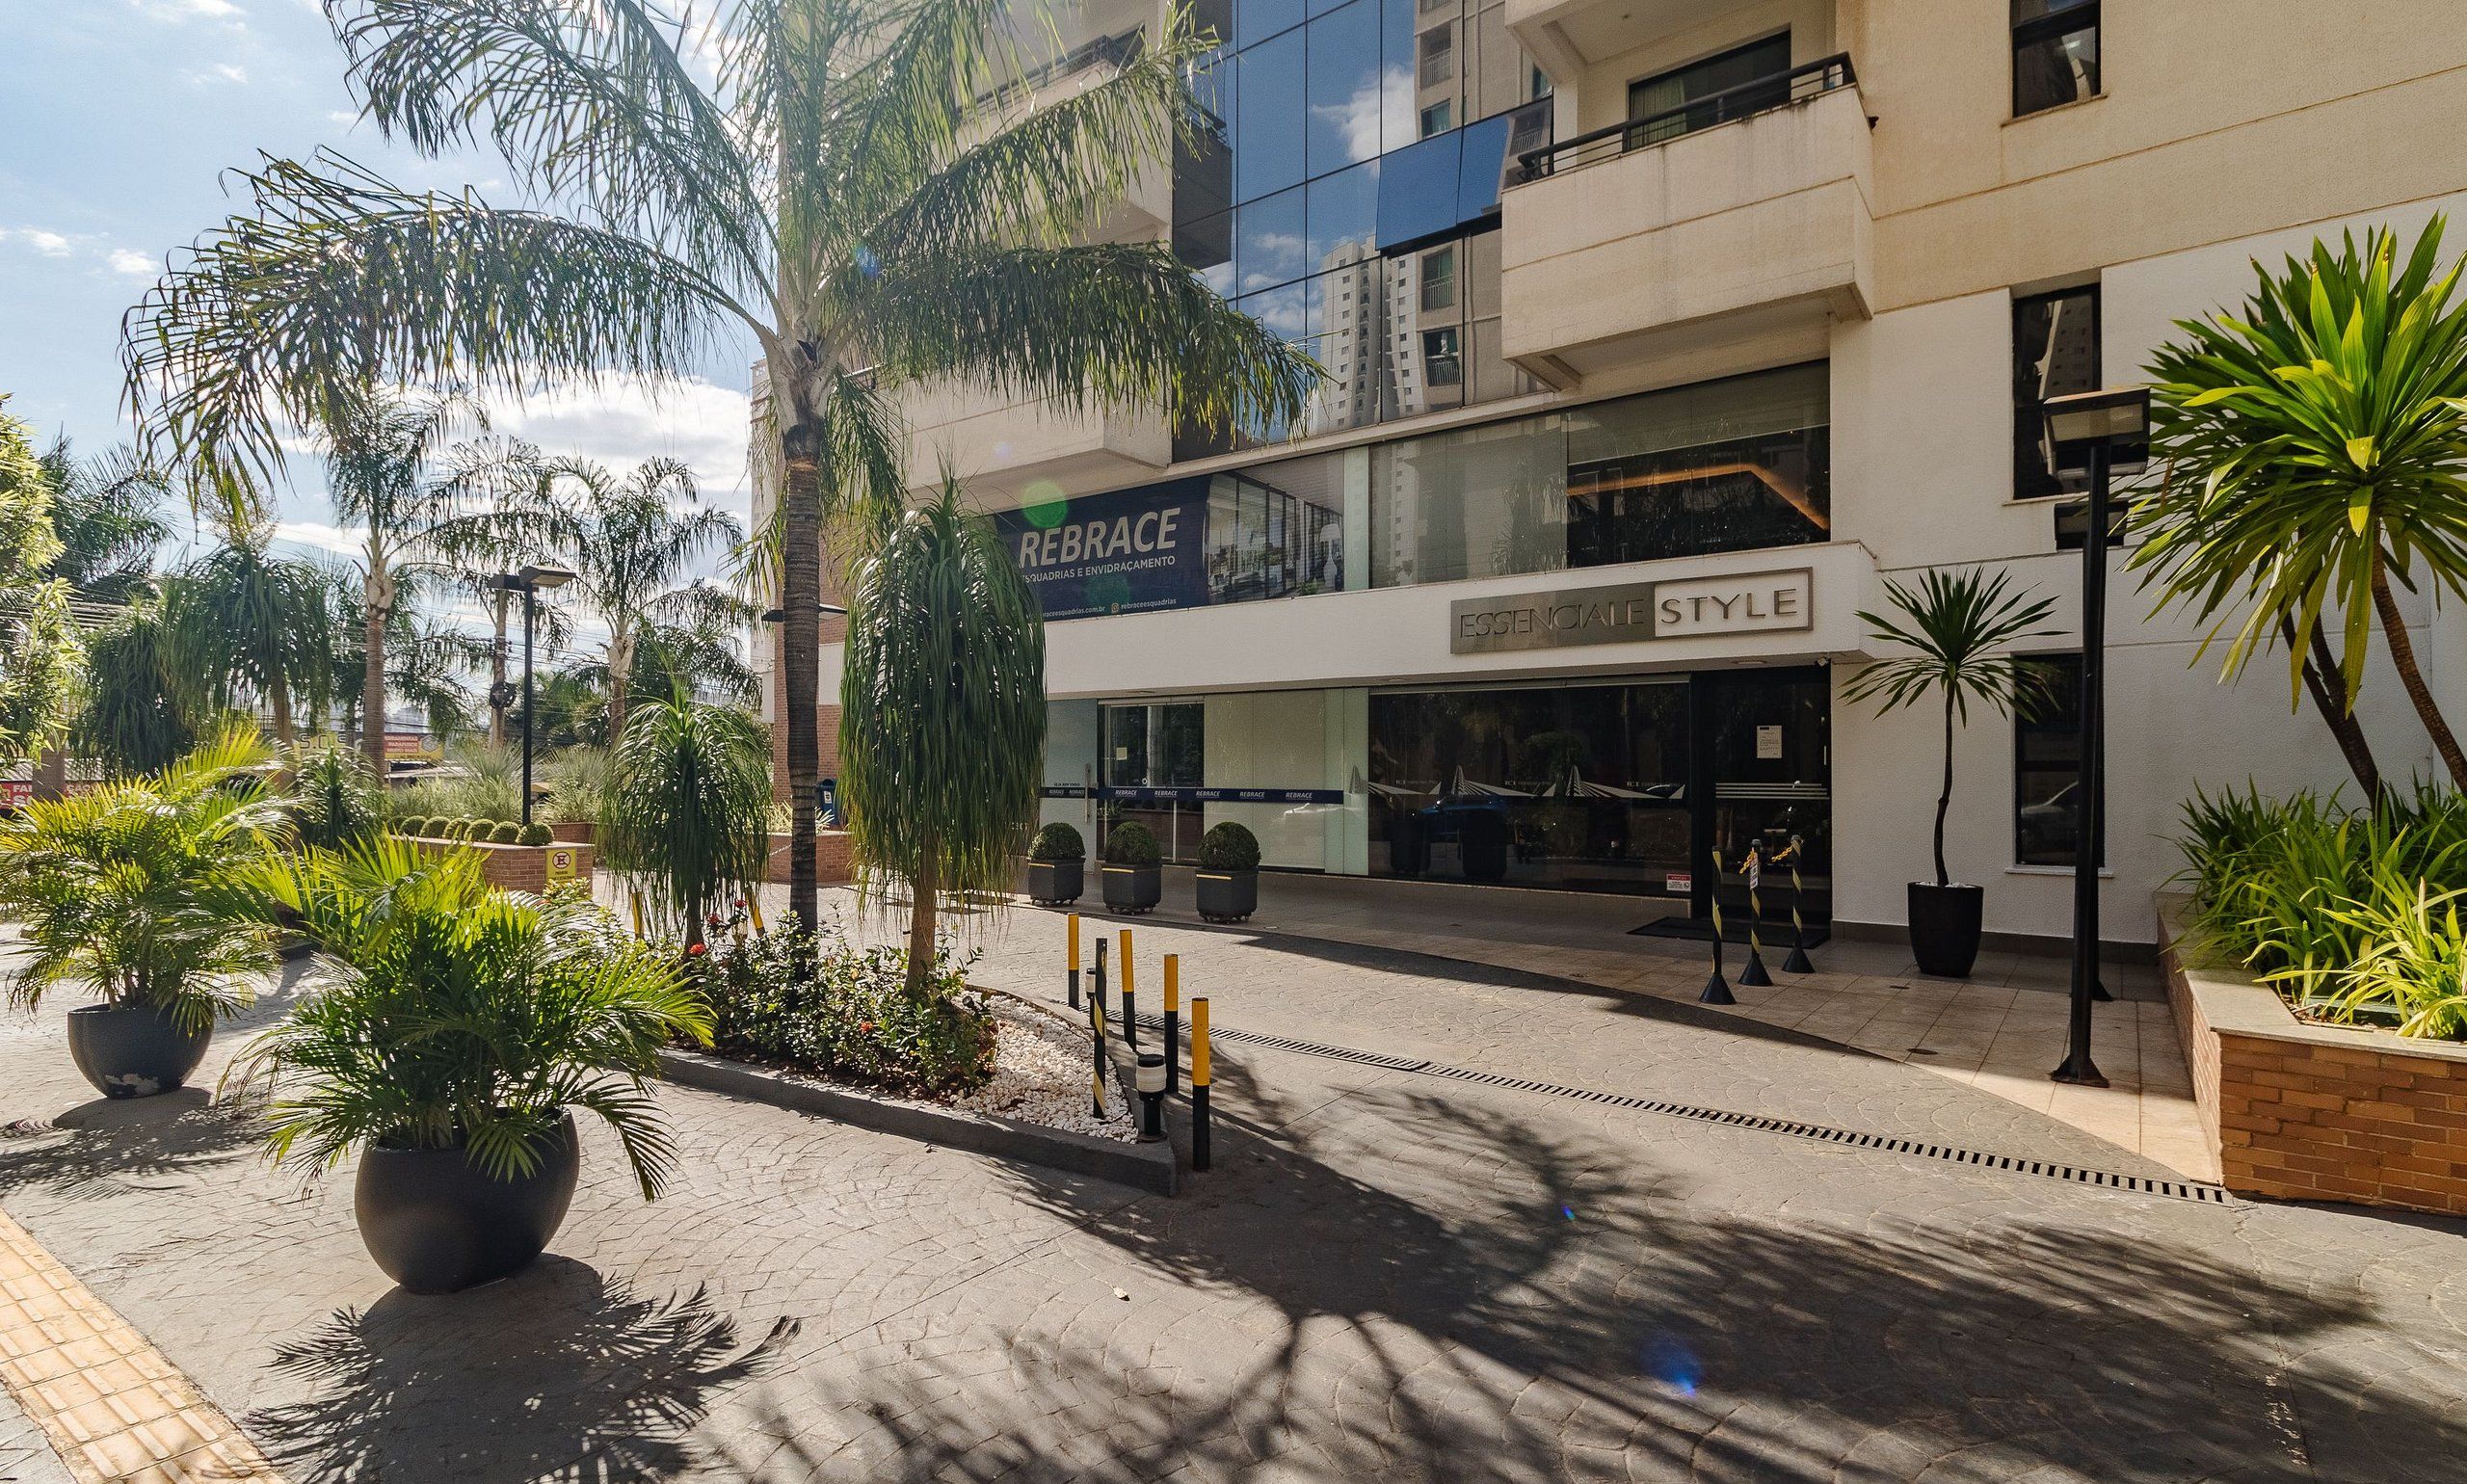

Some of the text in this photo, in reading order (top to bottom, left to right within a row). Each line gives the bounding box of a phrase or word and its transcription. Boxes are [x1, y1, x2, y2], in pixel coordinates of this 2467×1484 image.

[1019, 508, 1180, 569] REBRACE
[1077, 567, 1083, 576] E
[1085, 555, 1176, 576] ENVIDRAÇAMENTO
[1121, 597, 1177, 610] rebraceesquadrias
[1459, 588, 1798, 638] ESSENCIALE STYLE
